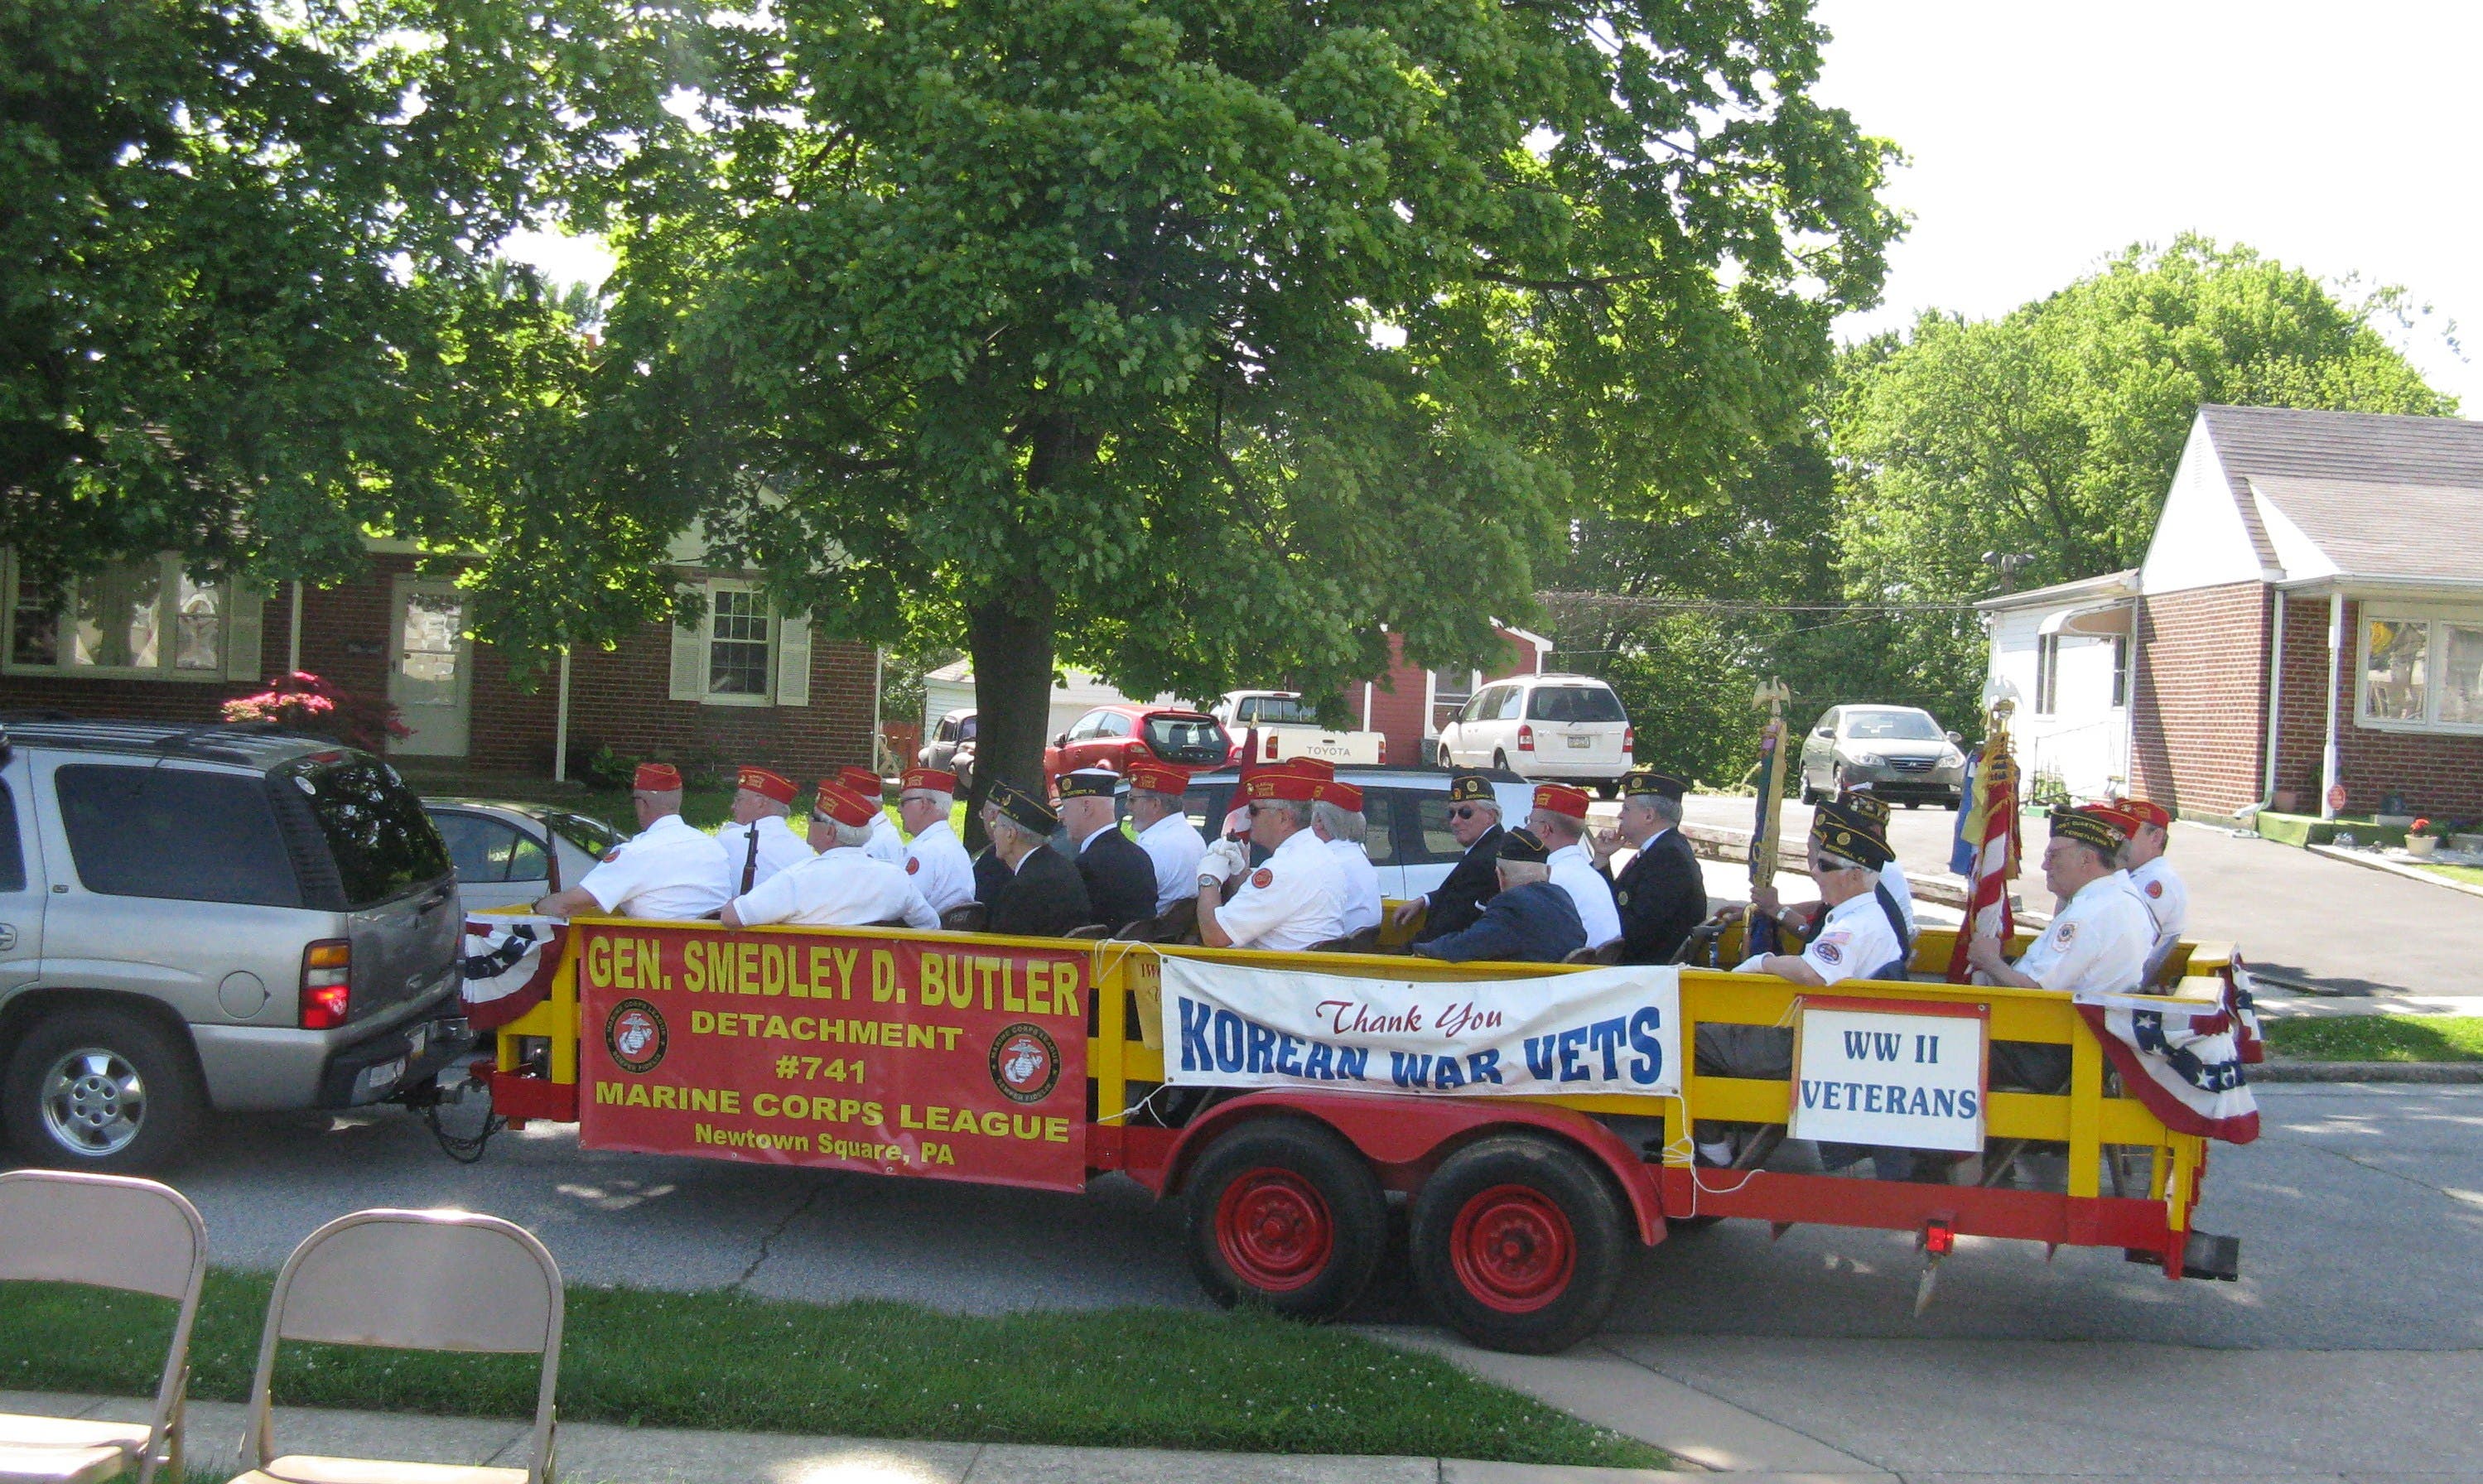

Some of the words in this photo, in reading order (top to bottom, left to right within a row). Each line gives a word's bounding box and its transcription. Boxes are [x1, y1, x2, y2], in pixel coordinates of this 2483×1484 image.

[1306, 745, 1352, 756] TOYOTA
[588, 936, 673, 991] GEN.
[683, 939, 859, 1000] SMEDLEY
[872, 949, 907, 1005] D.
[920, 952, 1081, 1017] BUTLER
[691, 1009, 963, 1051] DETACHMENT
[1315, 1000, 1423, 1034] Thank
[1434, 1001, 1503, 1038] You
[1178, 996, 1370, 1082] KOREAN
[1390, 1048, 1503, 1091] WAR
[1524, 1005, 1663, 1085] VETS
[1844, 1030, 1902, 1062] WW
[1914, 1034, 1940, 1064] II
[775, 1054, 865, 1084] #741
[595, 1081, 740, 1115] MARINE
[752, 1092, 884, 1126] CORPS
[899, 1104, 1070, 1143] LEAGUE
[1801, 1079, 1977, 1120] VETERANS
[695, 1123, 810, 1152] Newtown
[817, 1132, 911, 1164] Square,
[920, 1141, 955, 1166] PA
